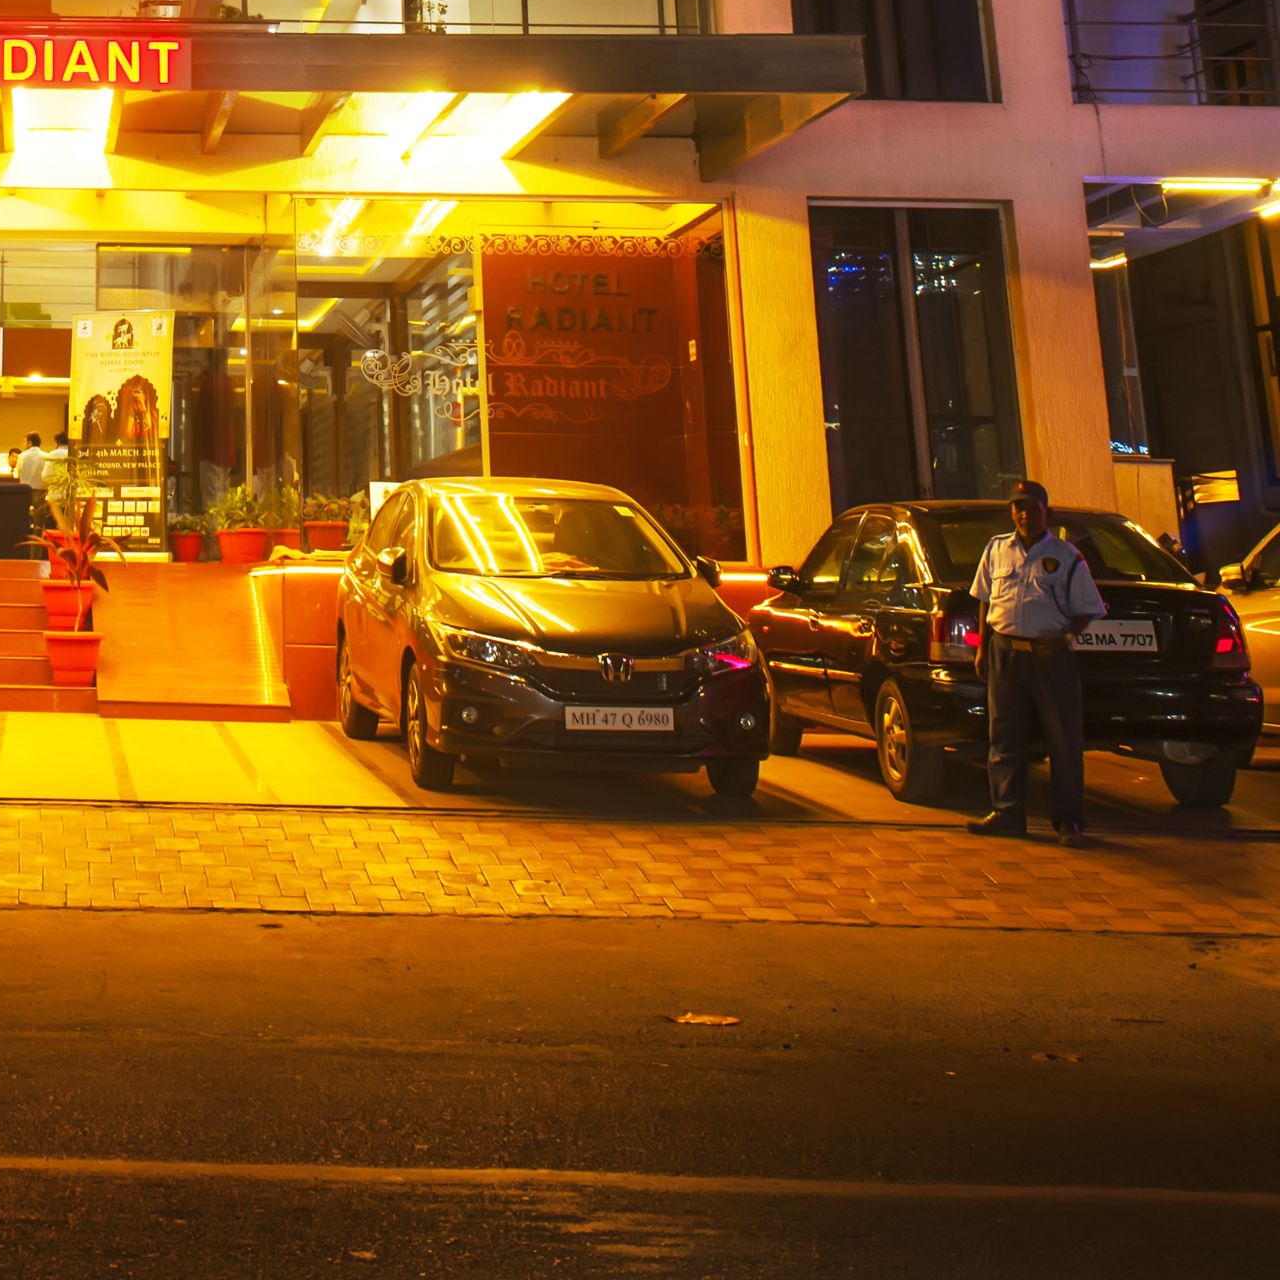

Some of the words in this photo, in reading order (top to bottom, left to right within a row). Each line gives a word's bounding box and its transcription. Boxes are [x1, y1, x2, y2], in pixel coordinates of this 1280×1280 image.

[526, 269, 632, 297] HOTEL
[504, 306, 657, 333] RADIANT
[504, 371, 609, 398] Radiant
[1076, 633, 1094, 646] 02
[1095, 633, 1117, 646] MA
[1119, 633, 1154, 646] 7707
[571, 712, 596, 726] MH
[601, 712, 617, 726] 47
[622, 712, 633, 728] Q
[638, 712, 670, 726] 6980
